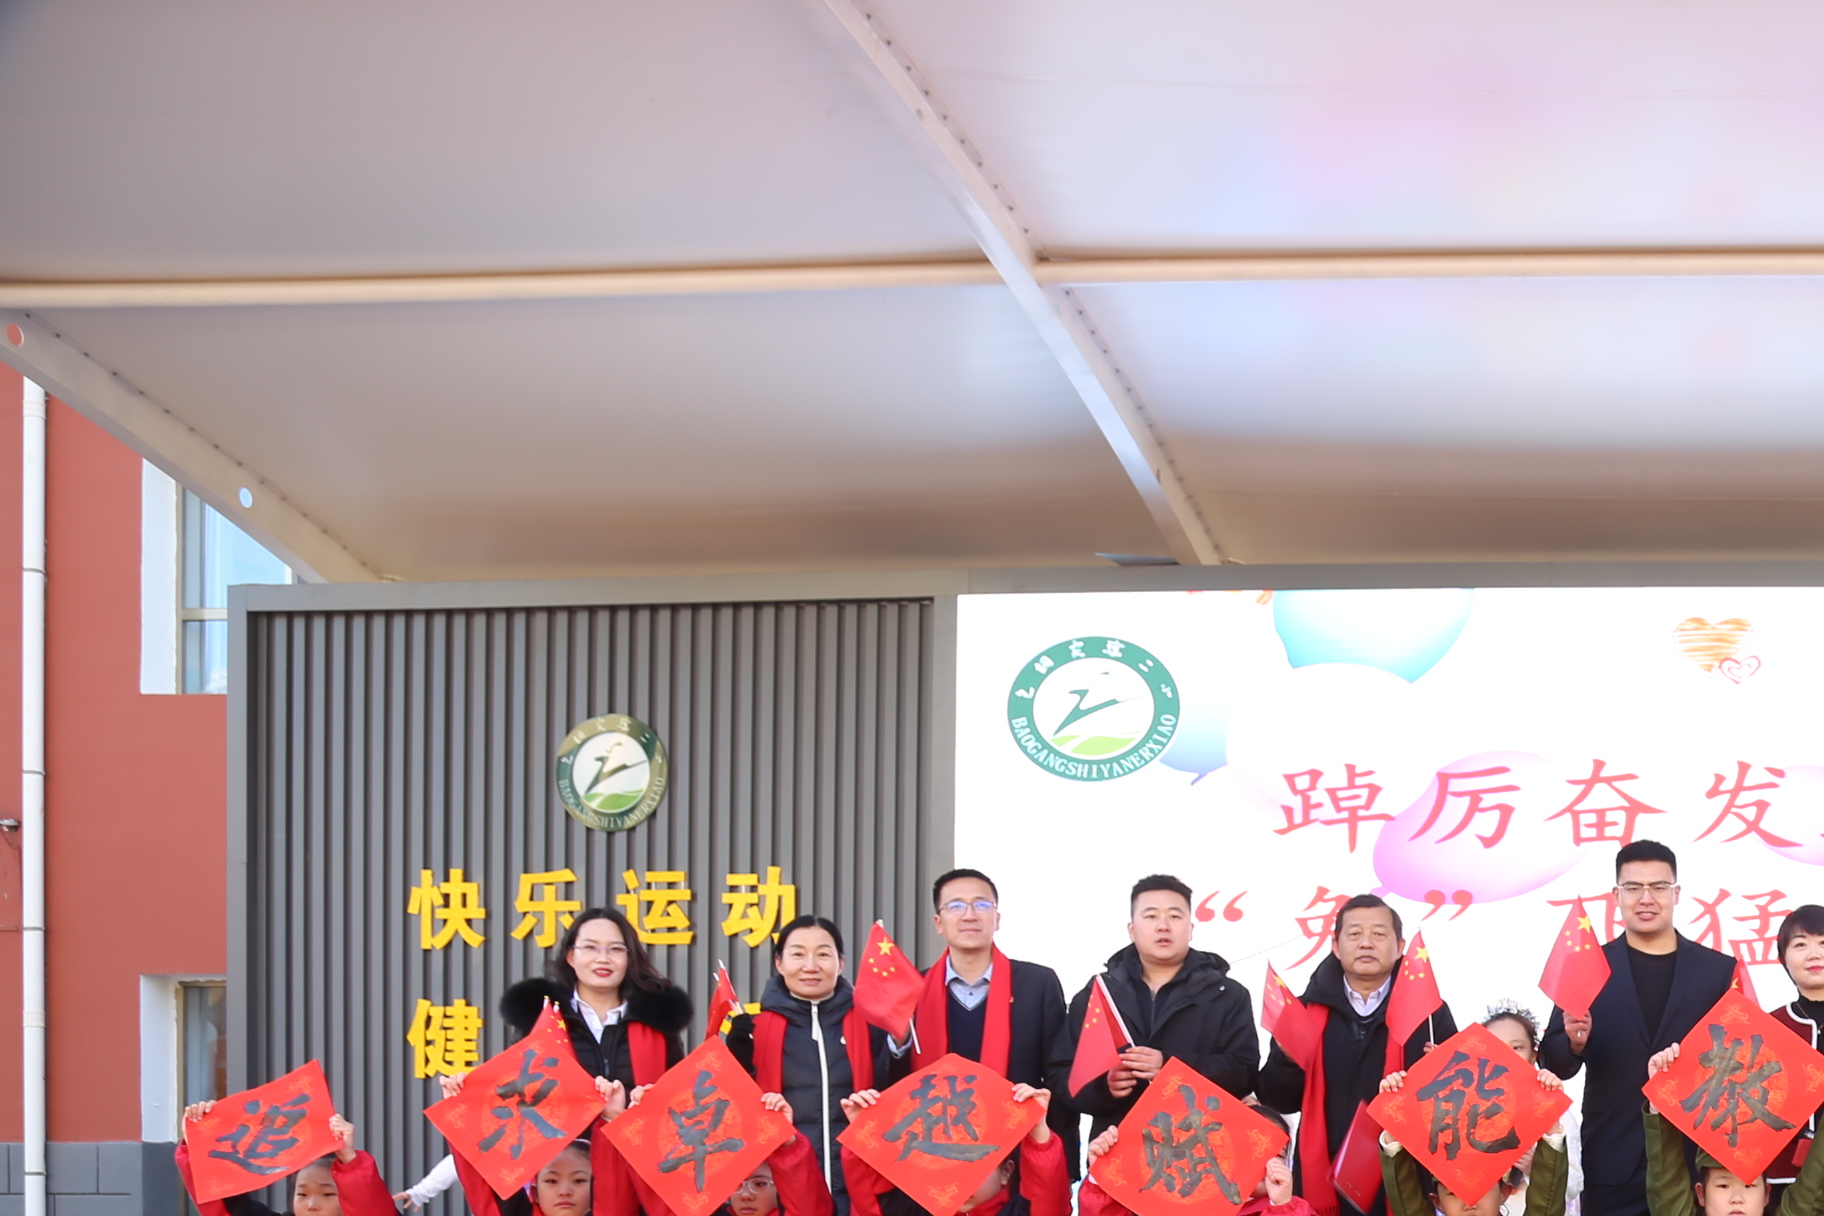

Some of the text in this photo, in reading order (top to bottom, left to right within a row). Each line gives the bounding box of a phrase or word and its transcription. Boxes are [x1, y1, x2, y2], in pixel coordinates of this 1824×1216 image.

[1012, 714, 1177, 779] BAOGANGSHIYANERXIAO
[407, 866, 797, 950] 快乐运动
[207, 1092, 313, 1176] 追
[478, 1048, 567, 1159] 求
[657, 1070, 745, 1193] 卓
[883, 1072, 1000, 1163] 越
[1415, 1050, 1521, 1161] 能
[1679, 1023, 1797, 1149] 教
[1139, 1083, 1243, 1205] 赋
